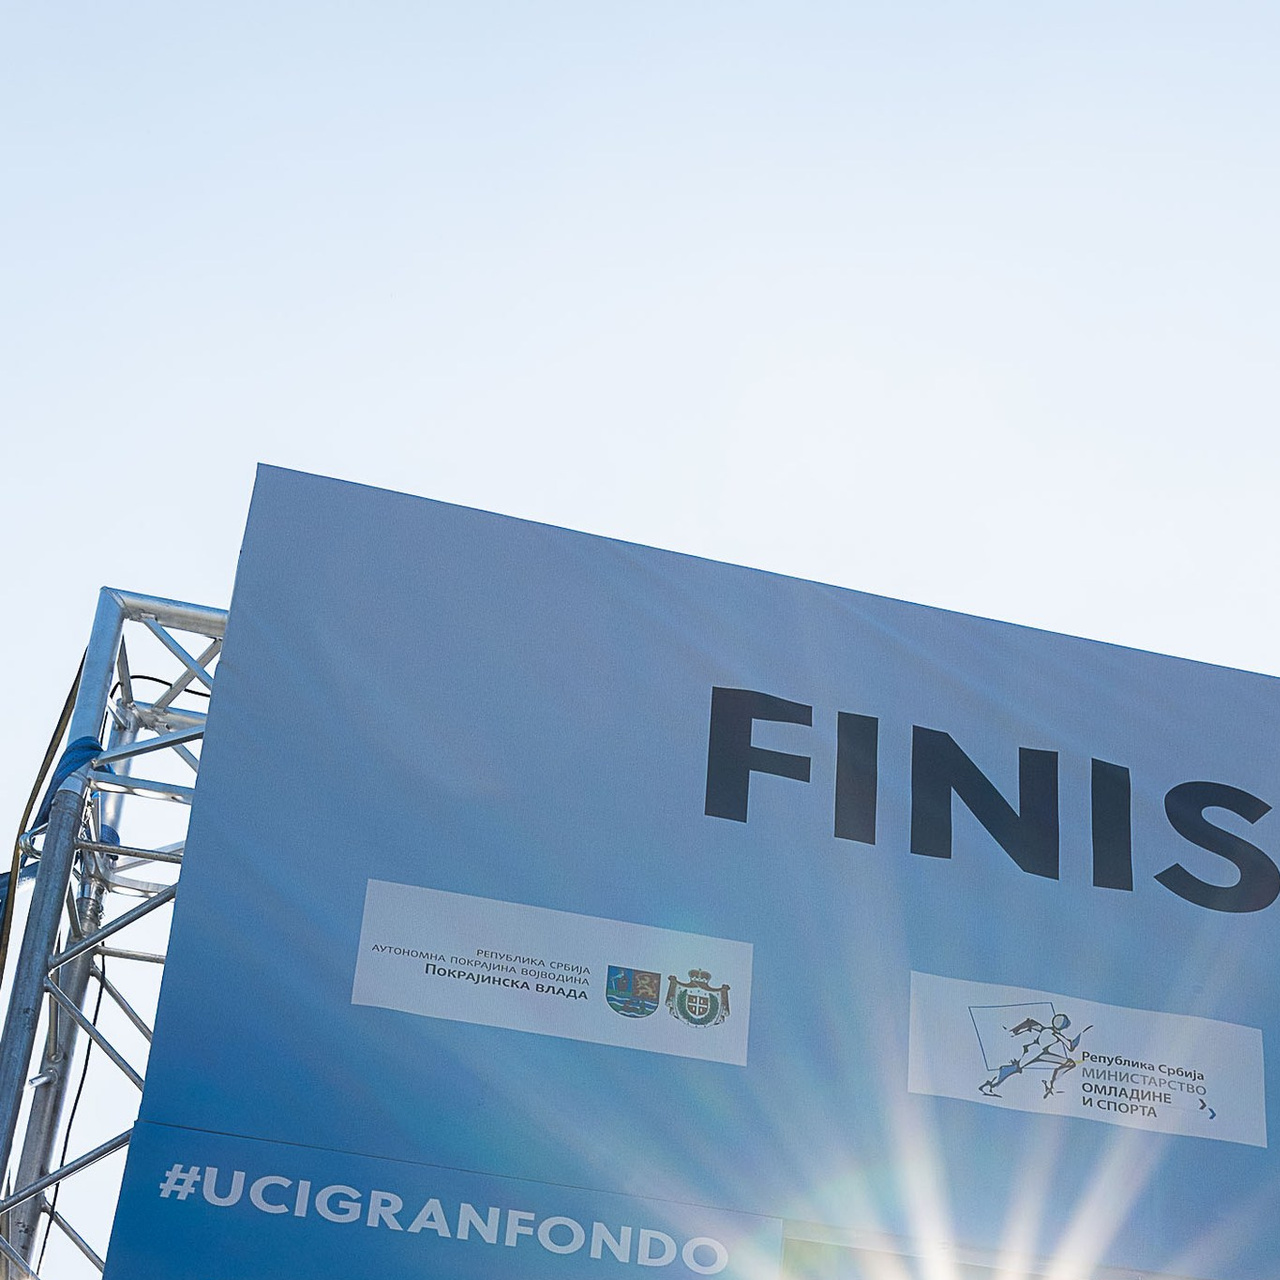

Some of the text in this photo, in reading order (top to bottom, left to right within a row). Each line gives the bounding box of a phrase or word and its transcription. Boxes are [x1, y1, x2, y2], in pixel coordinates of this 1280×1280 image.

[371, 944, 590, 985] АУТОНОМНА ПОКРАЈИНА ВОЈВОДИНА
[476, 949, 591, 975] РЕПУБЛИКА СРБИЈА
[1081, 1051, 1205, 1081] Република Србија
[1081, 1067, 1207, 1096] МИНИСТАРСТВО
[1081, 1083, 1172, 1105] ОМЛАДИНЕ
[1082, 1096, 1157, 1118] И СПОРТА
[159, 1163, 729, 1275] #UCIGRANFONDO
